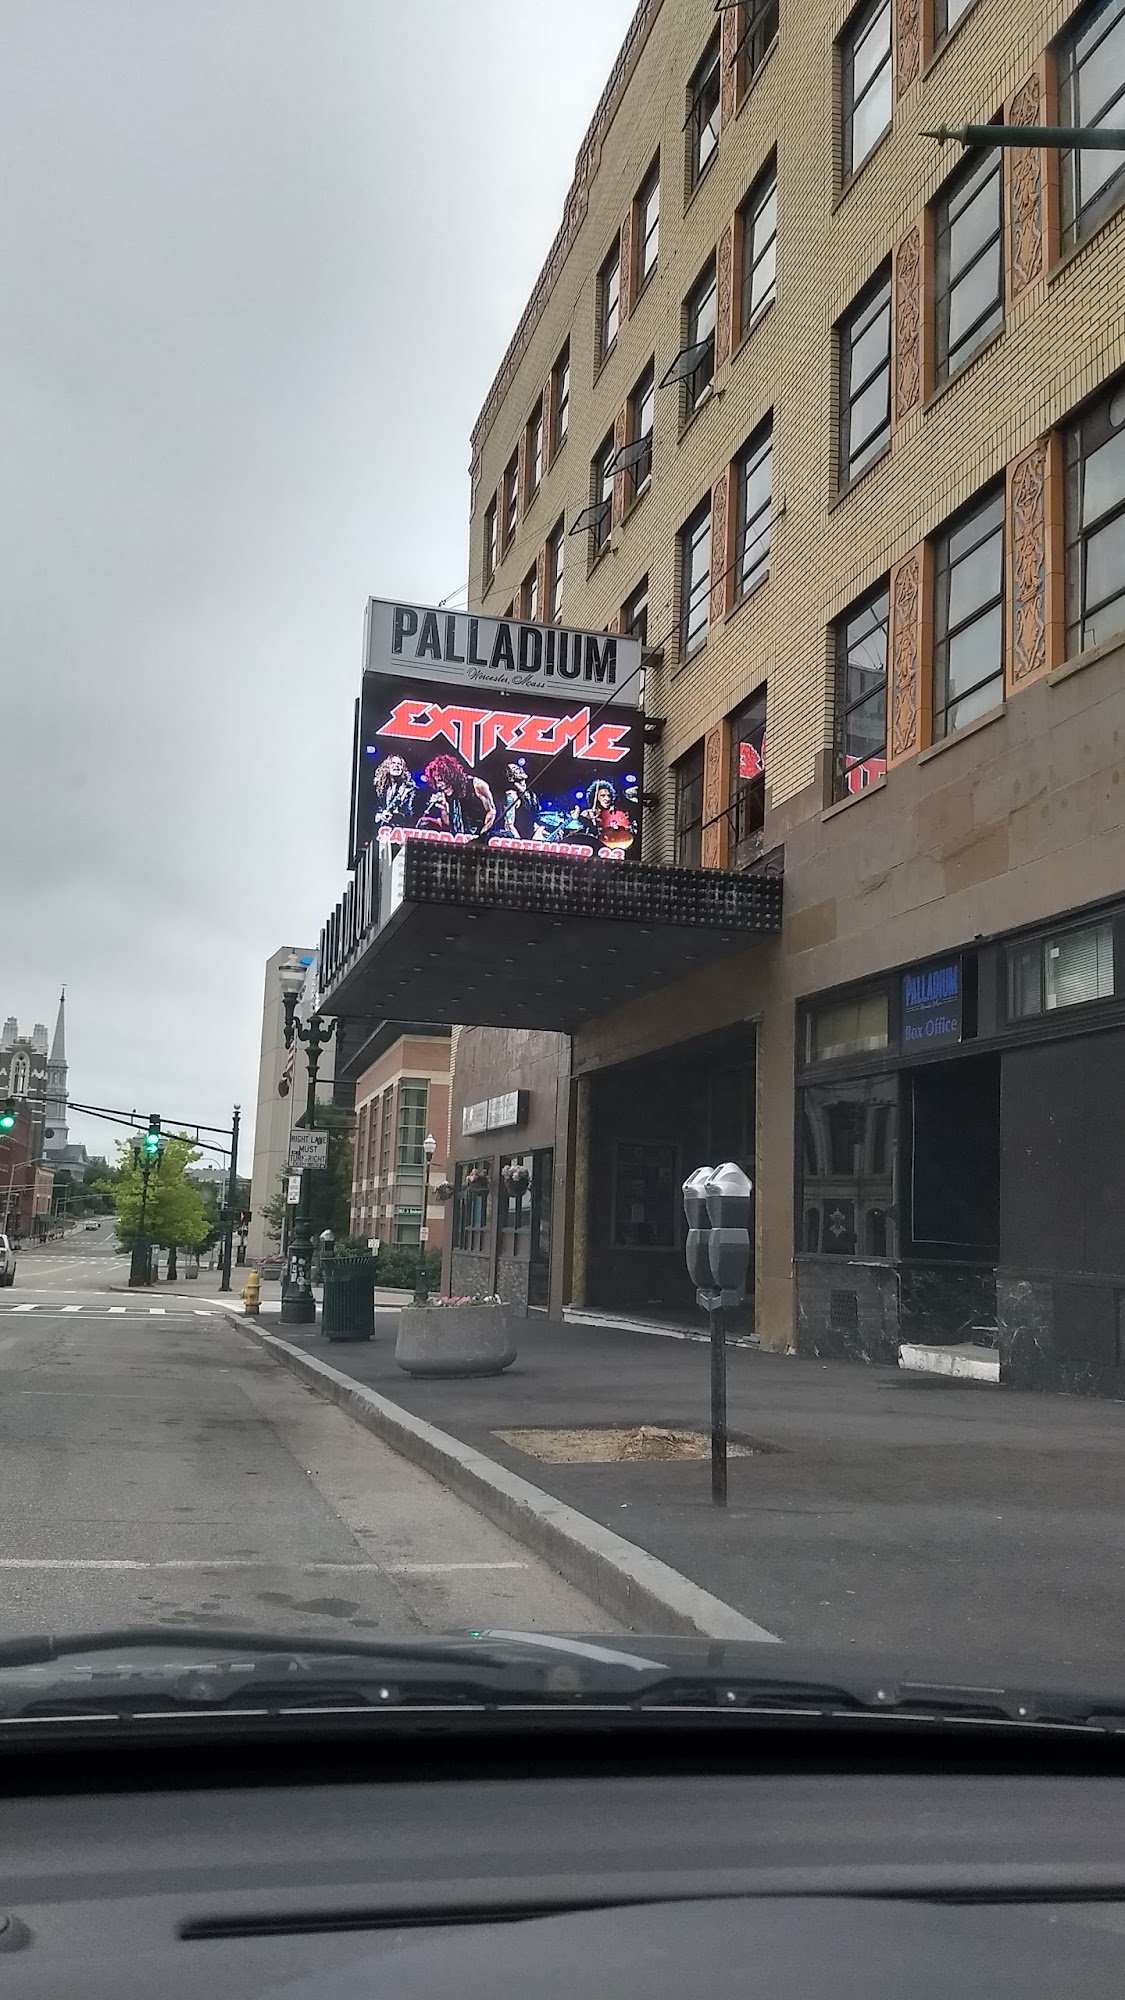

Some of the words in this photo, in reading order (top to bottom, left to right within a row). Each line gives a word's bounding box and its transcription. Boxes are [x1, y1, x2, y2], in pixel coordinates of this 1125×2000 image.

[391, 606, 618, 684] PALLADIUM
[512, 674, 545, 688] Mass
[376, 700, 631, 767] EXTREME
[905, 966, 957, 1006] PALLADIUM
[905, 1025, 923, 1040] Box
[925, 1016, 957, 1036] Office
[291, 1135, 309, 1143] RIGHT
[311, 1136, 327, 1144] LANE
[299, 1145, 318, 1153] MUST
[307, 1155, 325, 1163] RIGHT
